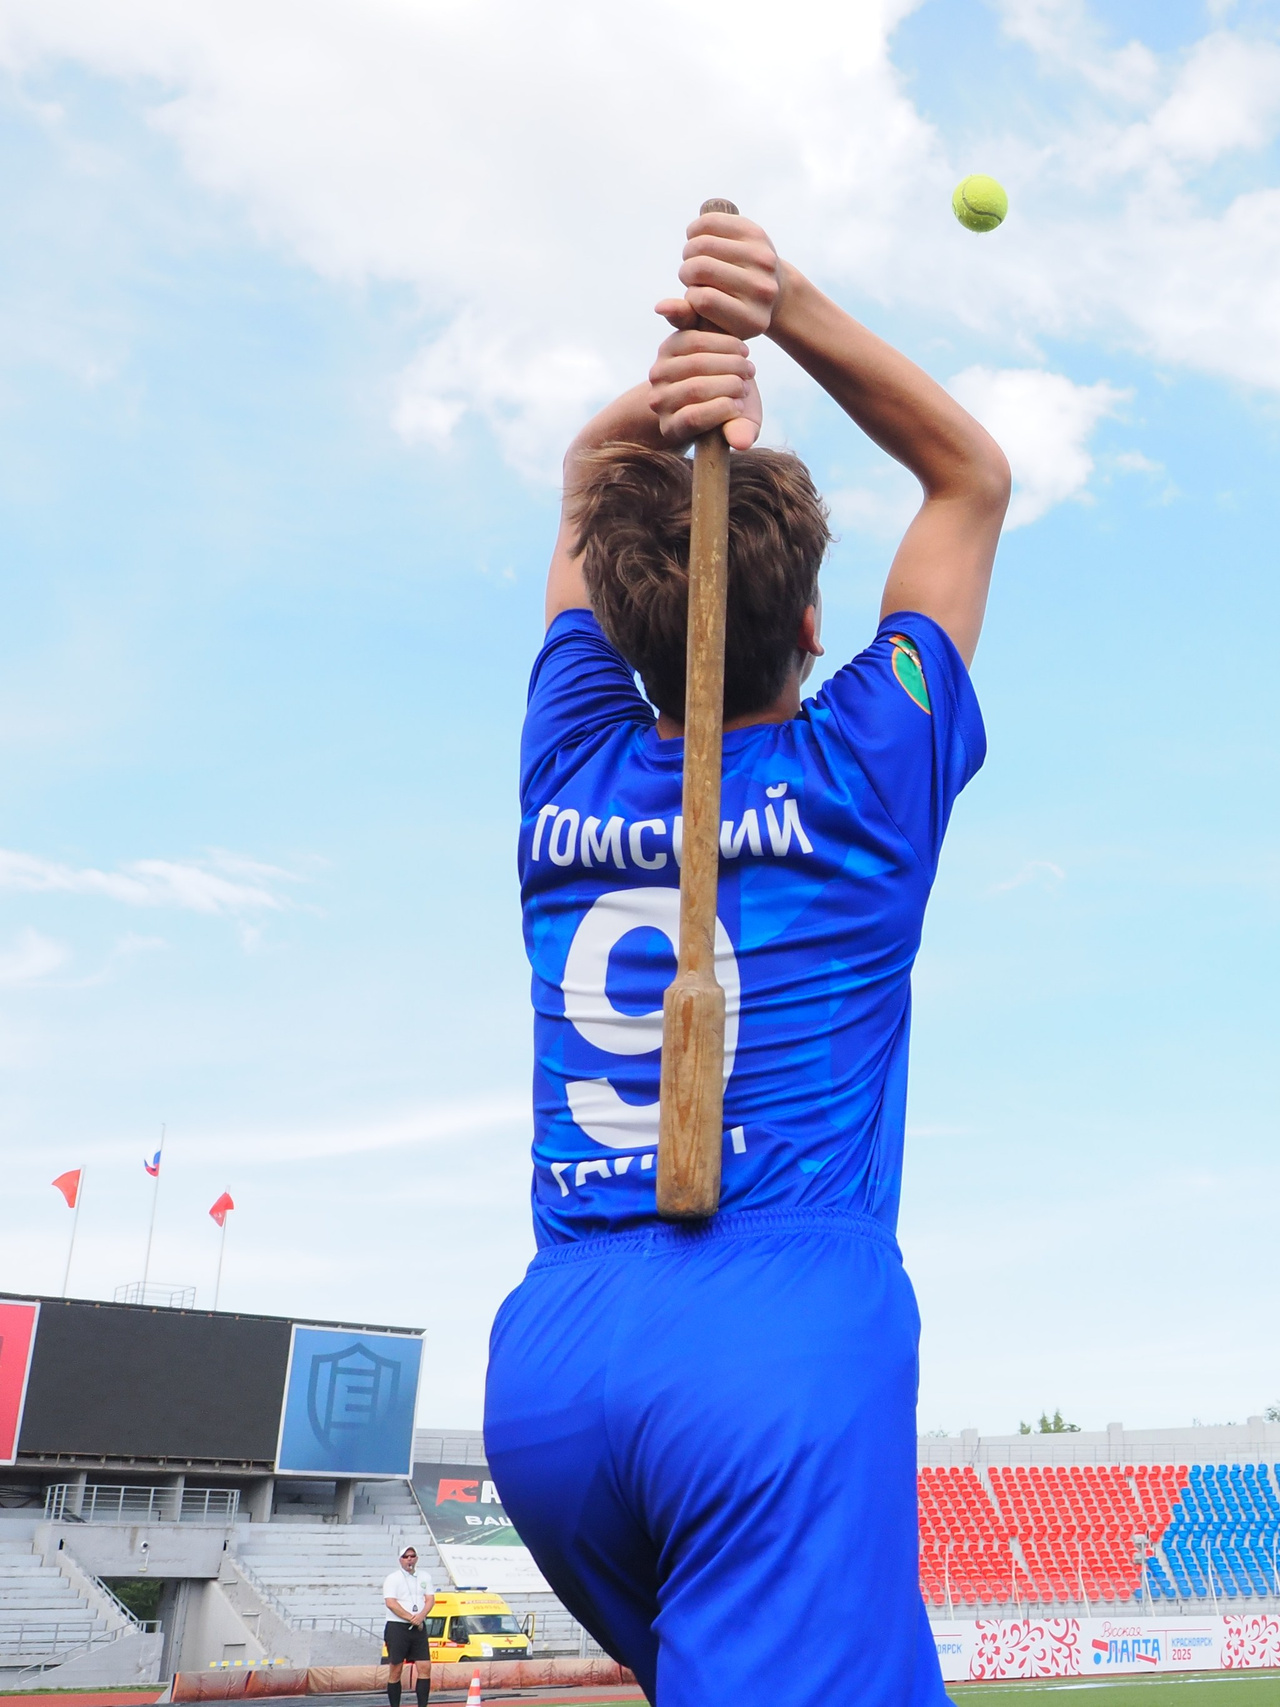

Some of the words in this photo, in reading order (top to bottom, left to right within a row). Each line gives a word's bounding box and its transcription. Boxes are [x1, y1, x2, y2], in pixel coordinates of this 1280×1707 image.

[560, 886, 741, 1149] 9
[1106, 1638, 1162, 1664] ЛАПТА
[1171, 1637, 1213, 1647] КРАСНОЯРСК
[1172, 1648, 1192, 1661] 2025
